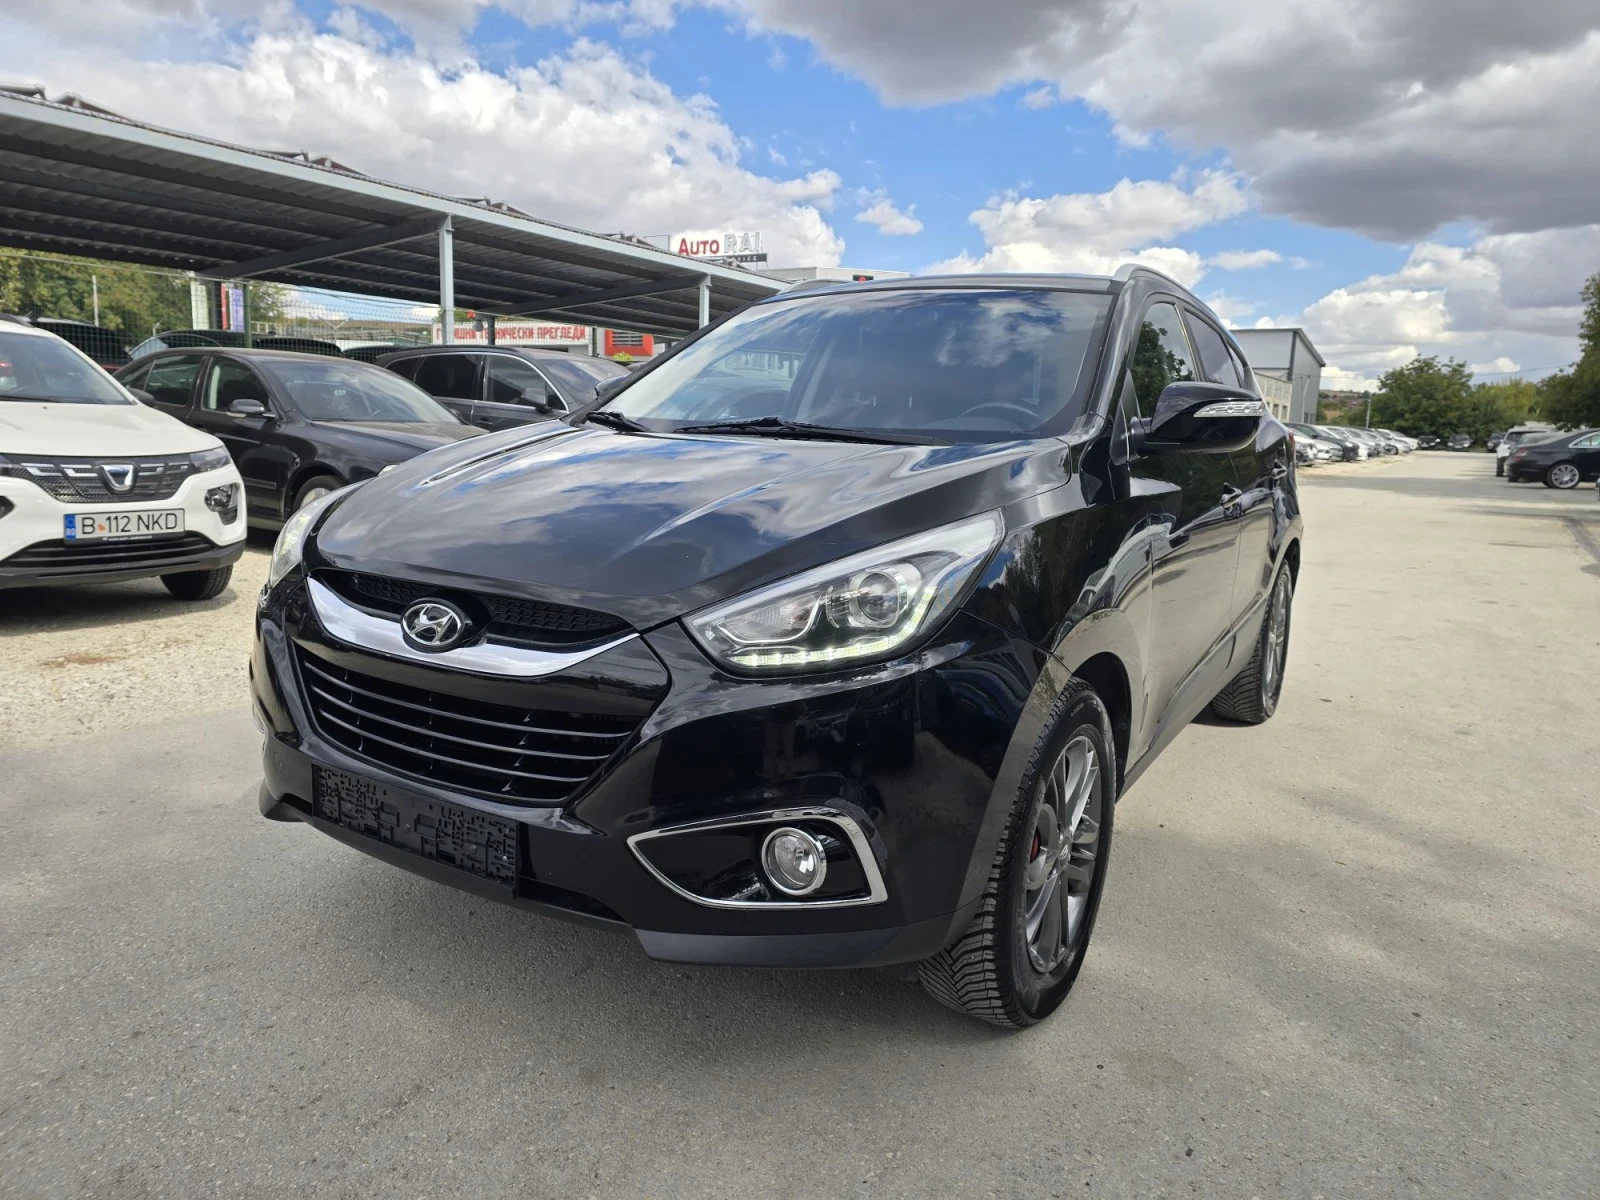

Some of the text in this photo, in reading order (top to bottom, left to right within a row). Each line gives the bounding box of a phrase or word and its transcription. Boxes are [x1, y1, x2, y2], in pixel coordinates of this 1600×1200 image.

[679, 232, 760, 255] AUTO RAI
[537, 325, 586, 341] ПРЕГЛЕДИ
[81, 512, 178, 535] B 112 NKD
